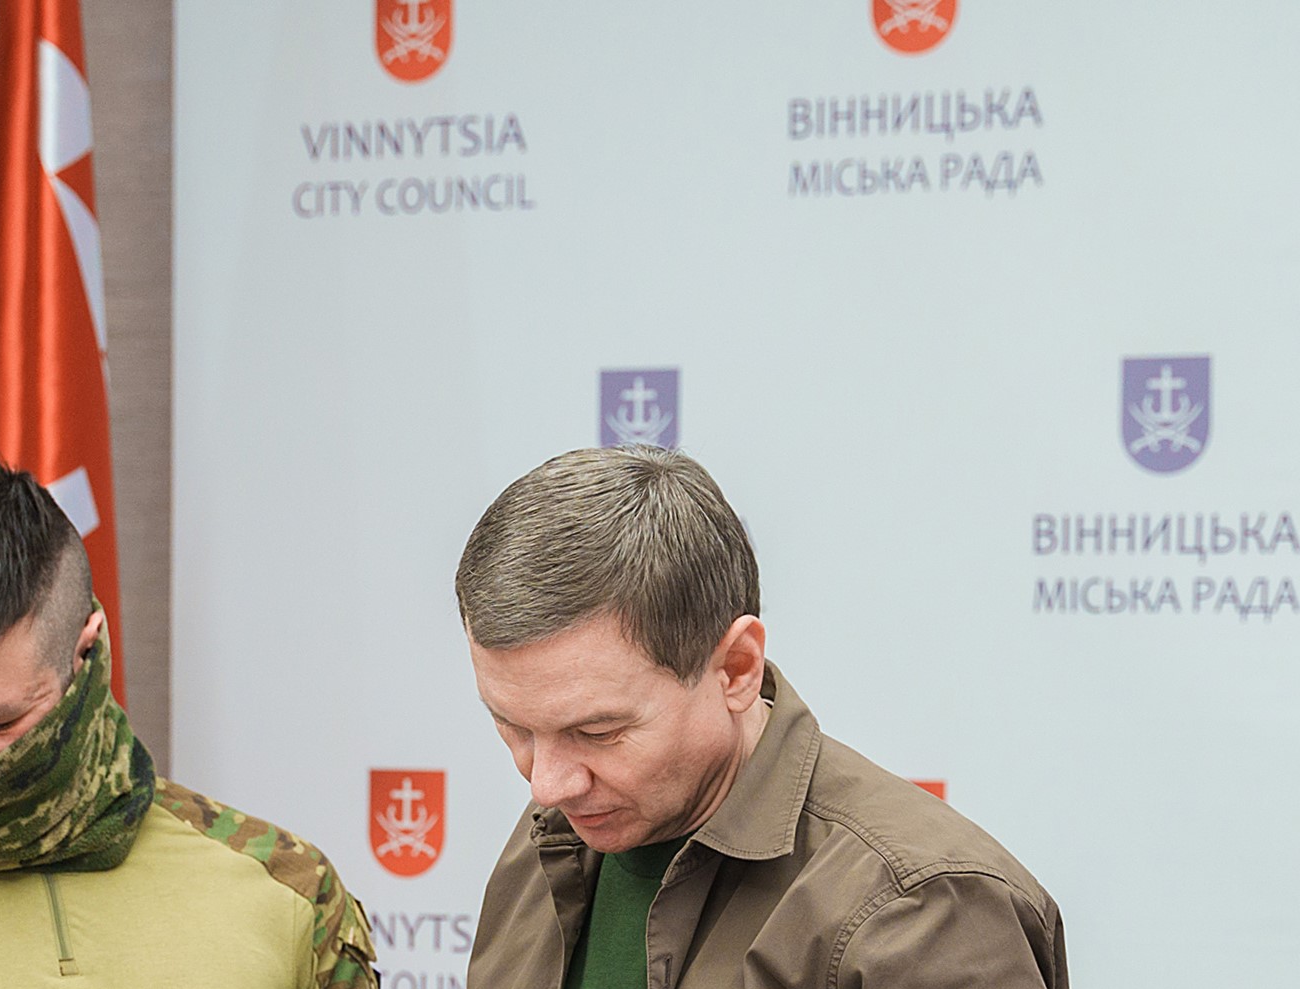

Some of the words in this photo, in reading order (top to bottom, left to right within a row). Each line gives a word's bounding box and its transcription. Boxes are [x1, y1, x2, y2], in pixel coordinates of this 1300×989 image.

[300, 113, 528, 162] VINNYTSIA
[787, 86, 1043, 142] ВІННИЦЬКА
[291, 181, 369, 219] CITY
[374, 173, 536, 216] COUNCIL
[787, 155, 931, 197] МІСЬКА
[939, 149, 1045, 199] РАДА
[1032, 511, 1300, 565] ВІННИЦЬКА
[1032, 576, 1182, 615] МІСЬКА
[1191, 575, 1300, 623] РАДА
